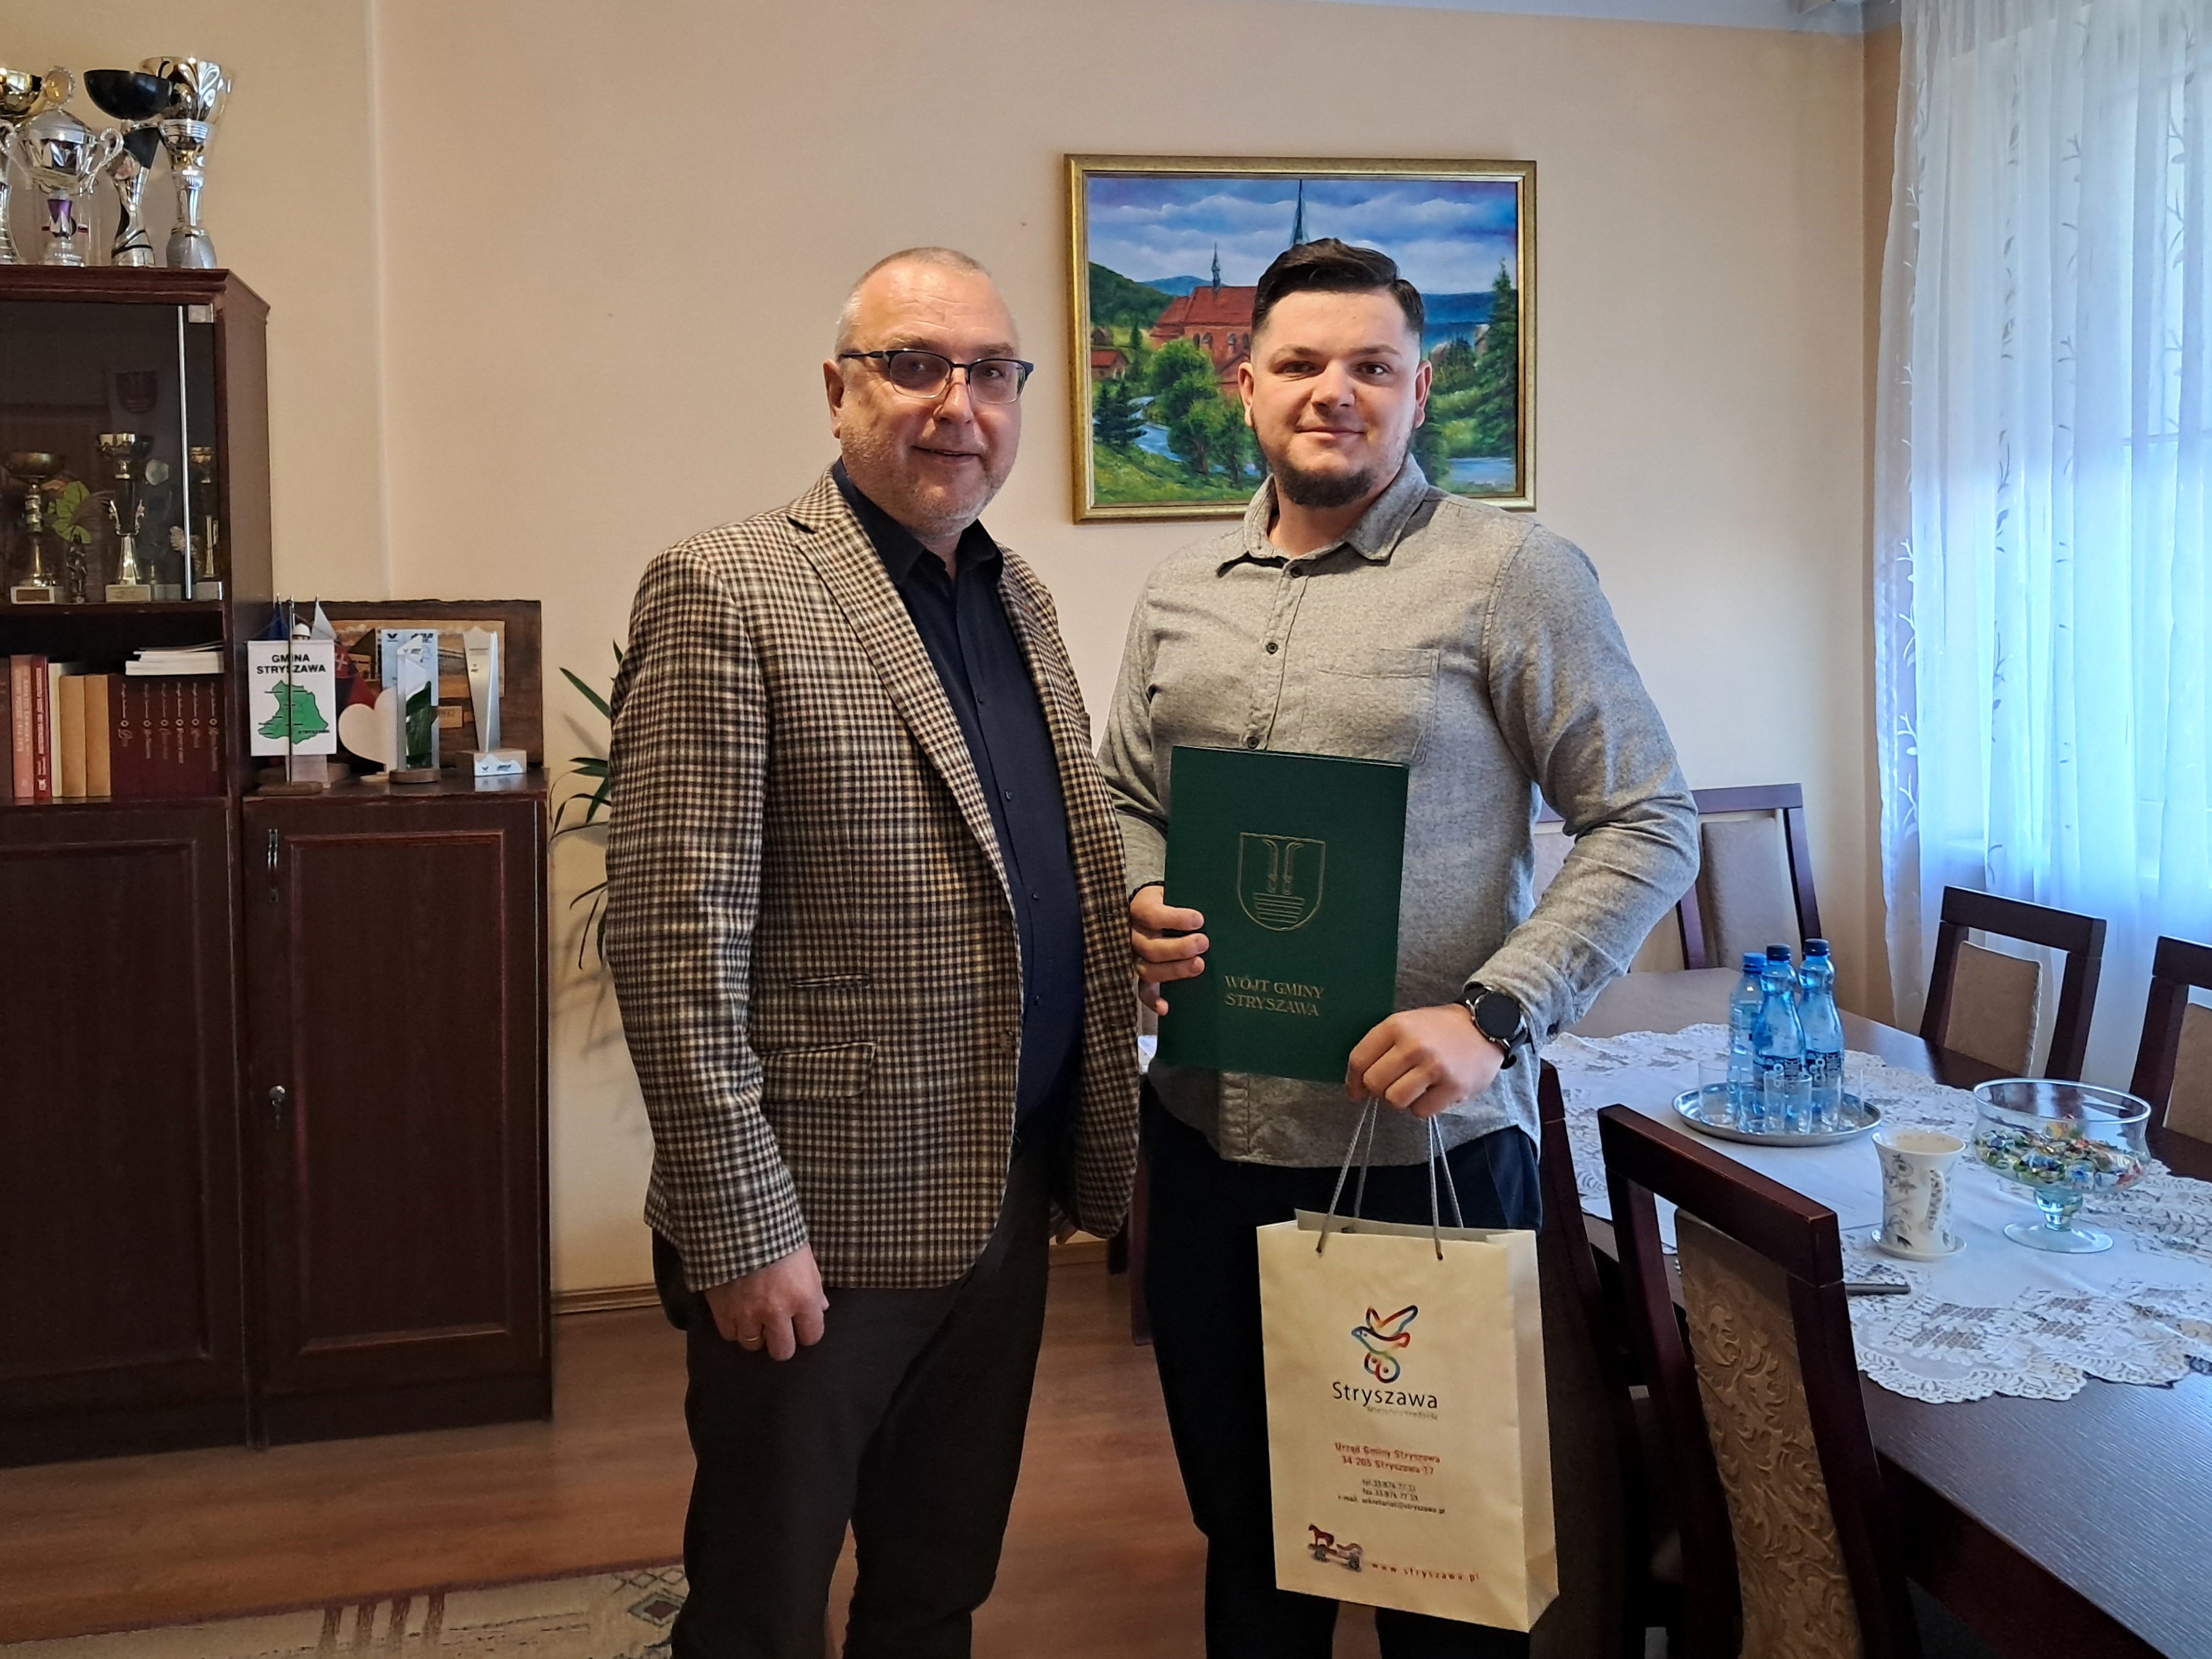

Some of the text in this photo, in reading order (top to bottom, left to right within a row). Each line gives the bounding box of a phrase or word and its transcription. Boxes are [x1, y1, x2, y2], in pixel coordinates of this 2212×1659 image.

[1224, 974, 1324, 999] WÓJT GMINY
[1225, 992, 1320, 1016] STRYSZAWA
[1332, 1381, 1438, 1409] Stryszawa
[1374, 1459, 1420, 1474] Stryszawa
[1394, 1449, 1441, 1463] Stryszawa
